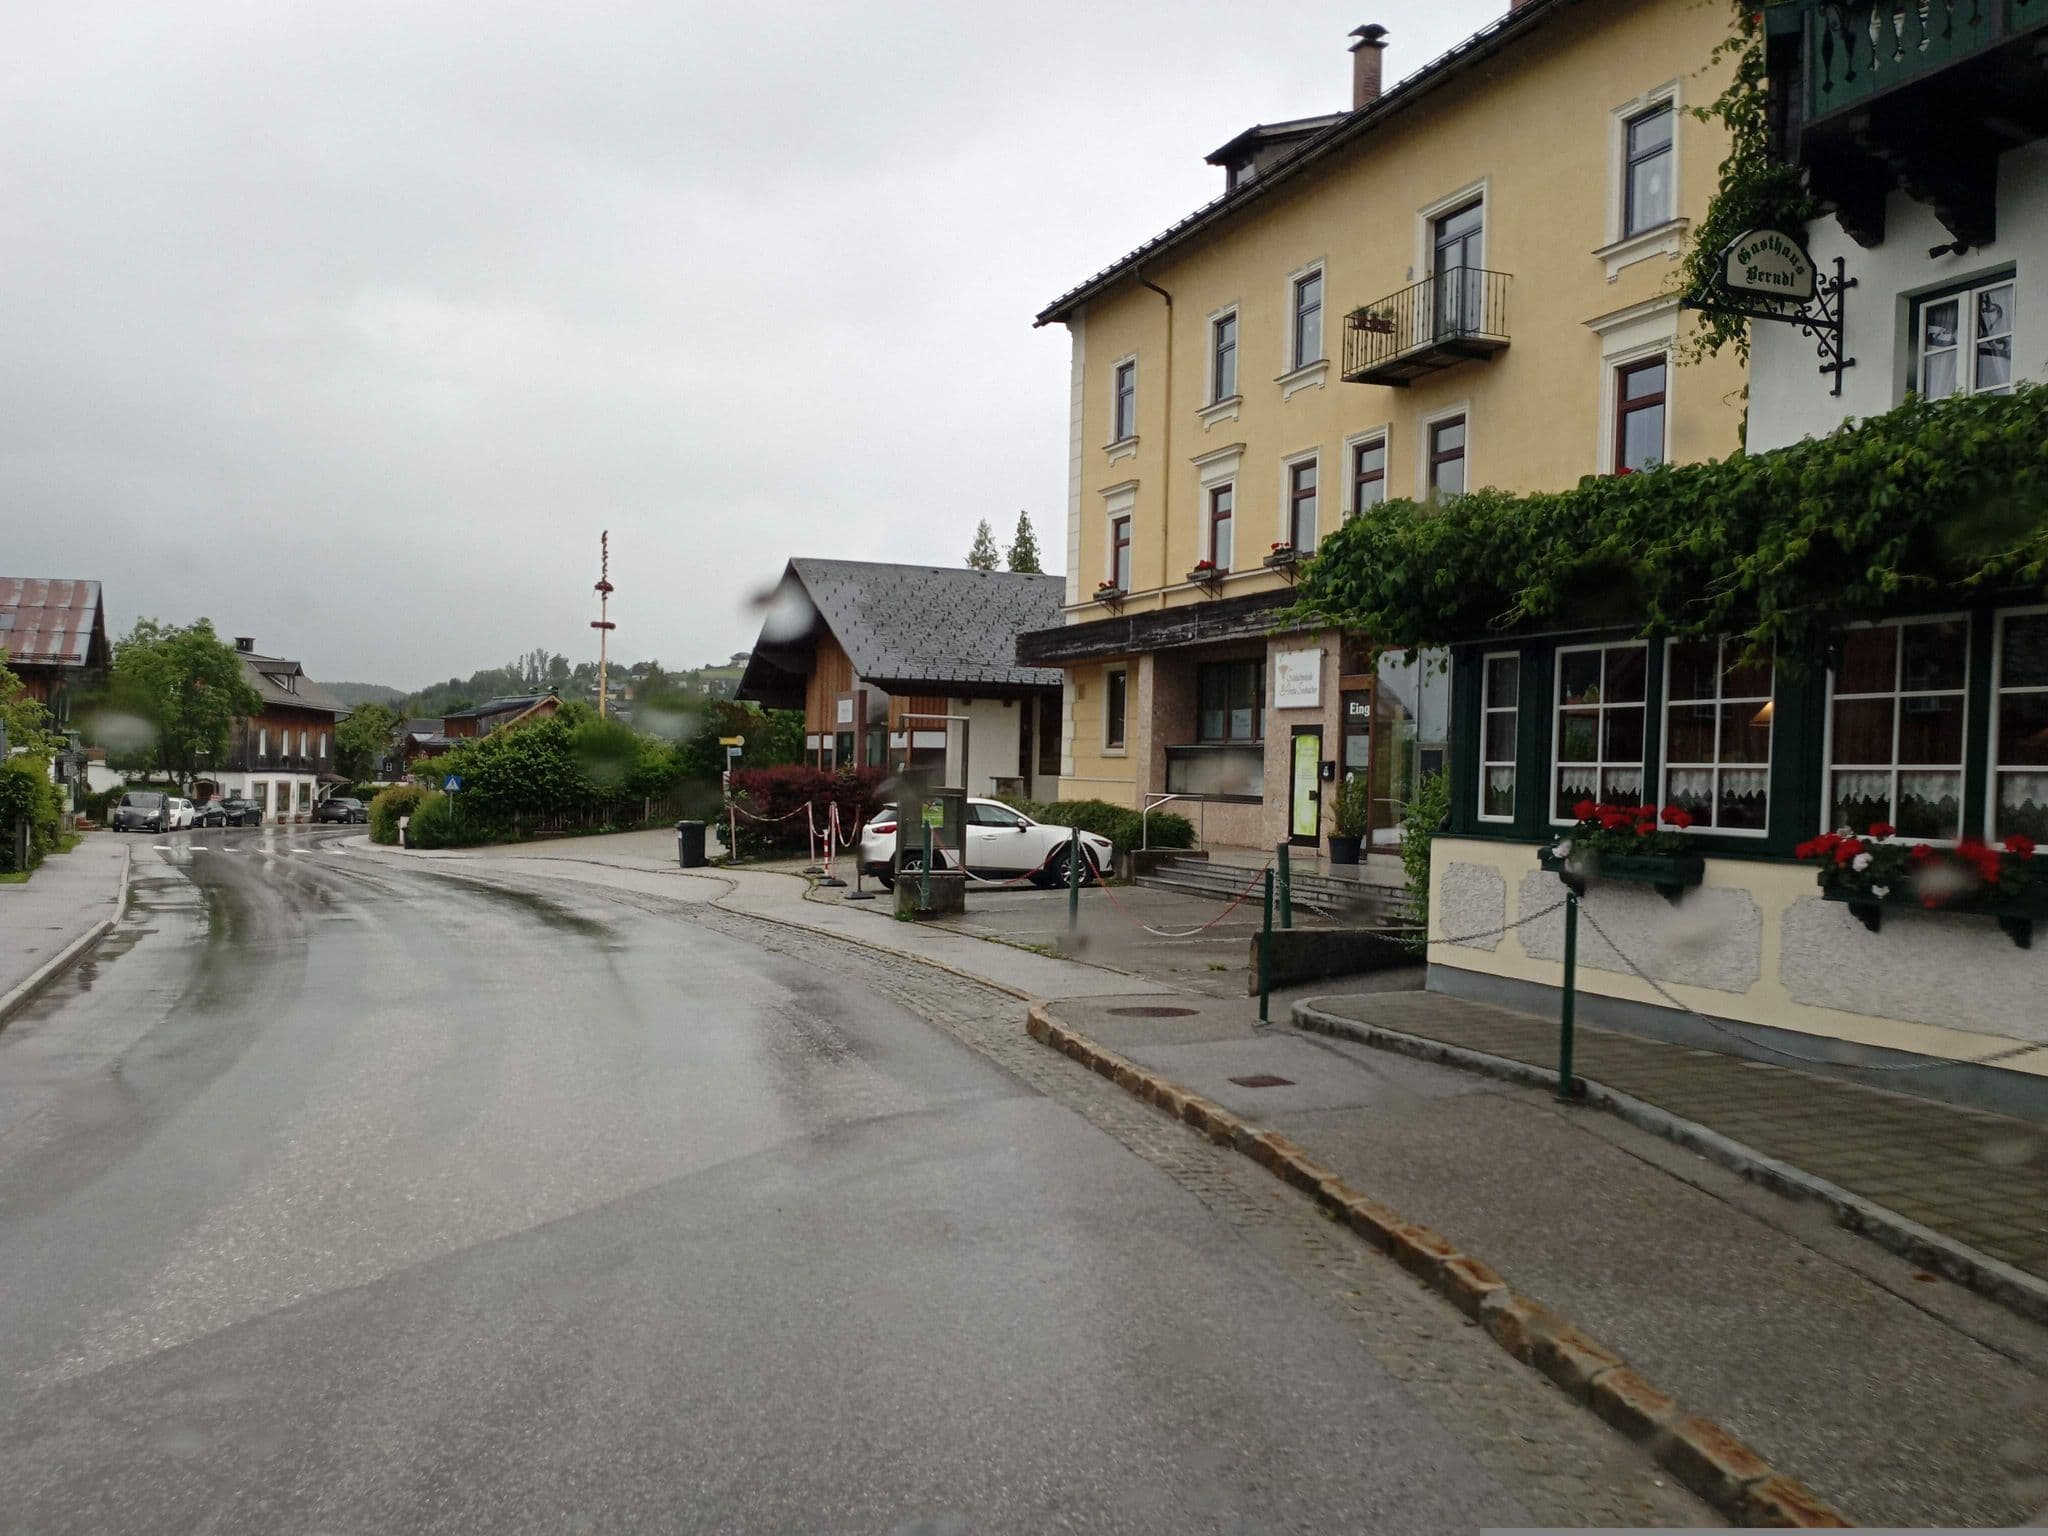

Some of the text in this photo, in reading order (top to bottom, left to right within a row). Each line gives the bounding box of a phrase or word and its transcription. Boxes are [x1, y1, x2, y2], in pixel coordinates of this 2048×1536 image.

[1737, 234, 1805, 275] Gasthaus
[1745, 264, 1795, 287] Berndl
[1349, 702, 1370, 717] Eing
